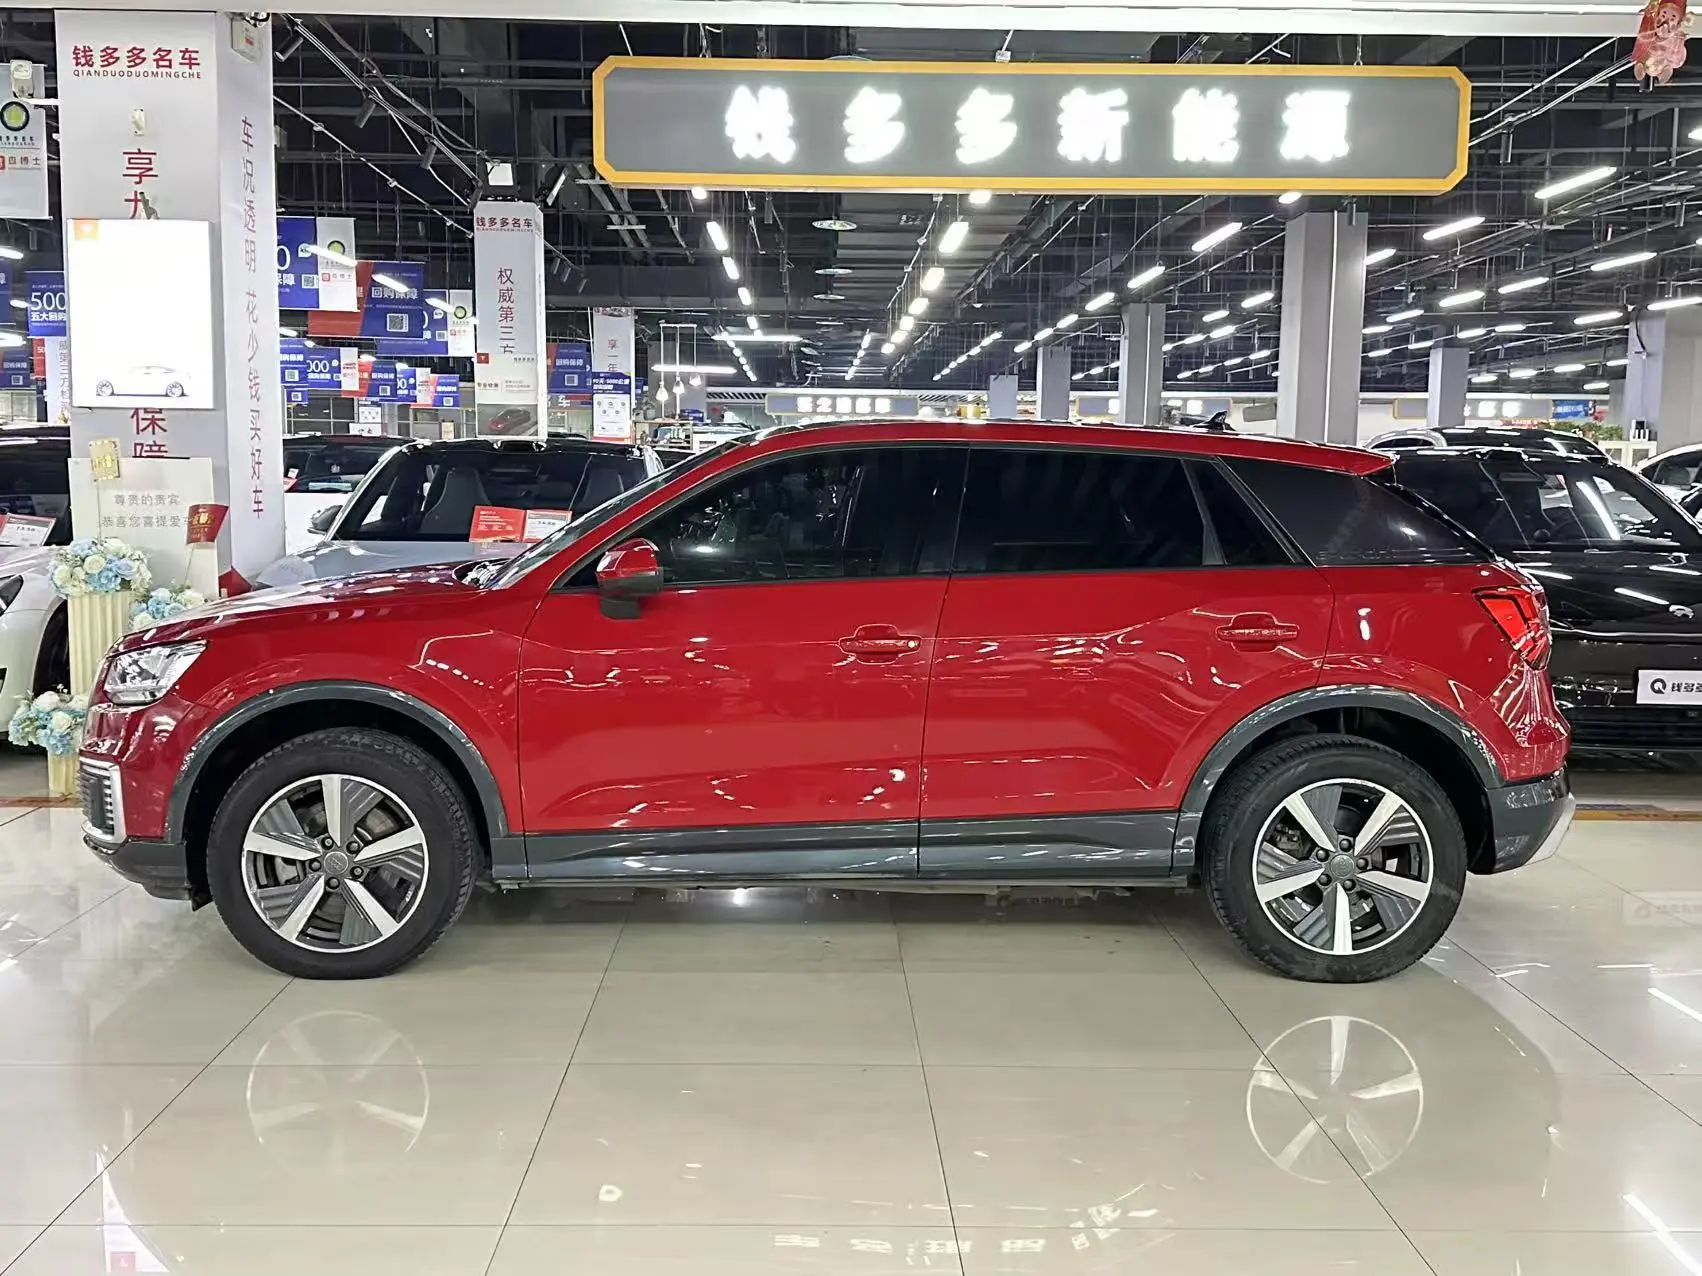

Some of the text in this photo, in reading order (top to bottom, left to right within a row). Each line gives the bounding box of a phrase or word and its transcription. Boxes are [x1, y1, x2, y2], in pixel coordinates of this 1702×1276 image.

[72, 45, 201, 70] 钱多多名车
[73, 69, 201, 79] QIANDUODUOMINGCHE
[475, 216, 533, 228] 钱多多名车
[497, 267, 515, 354] 权威第三方
